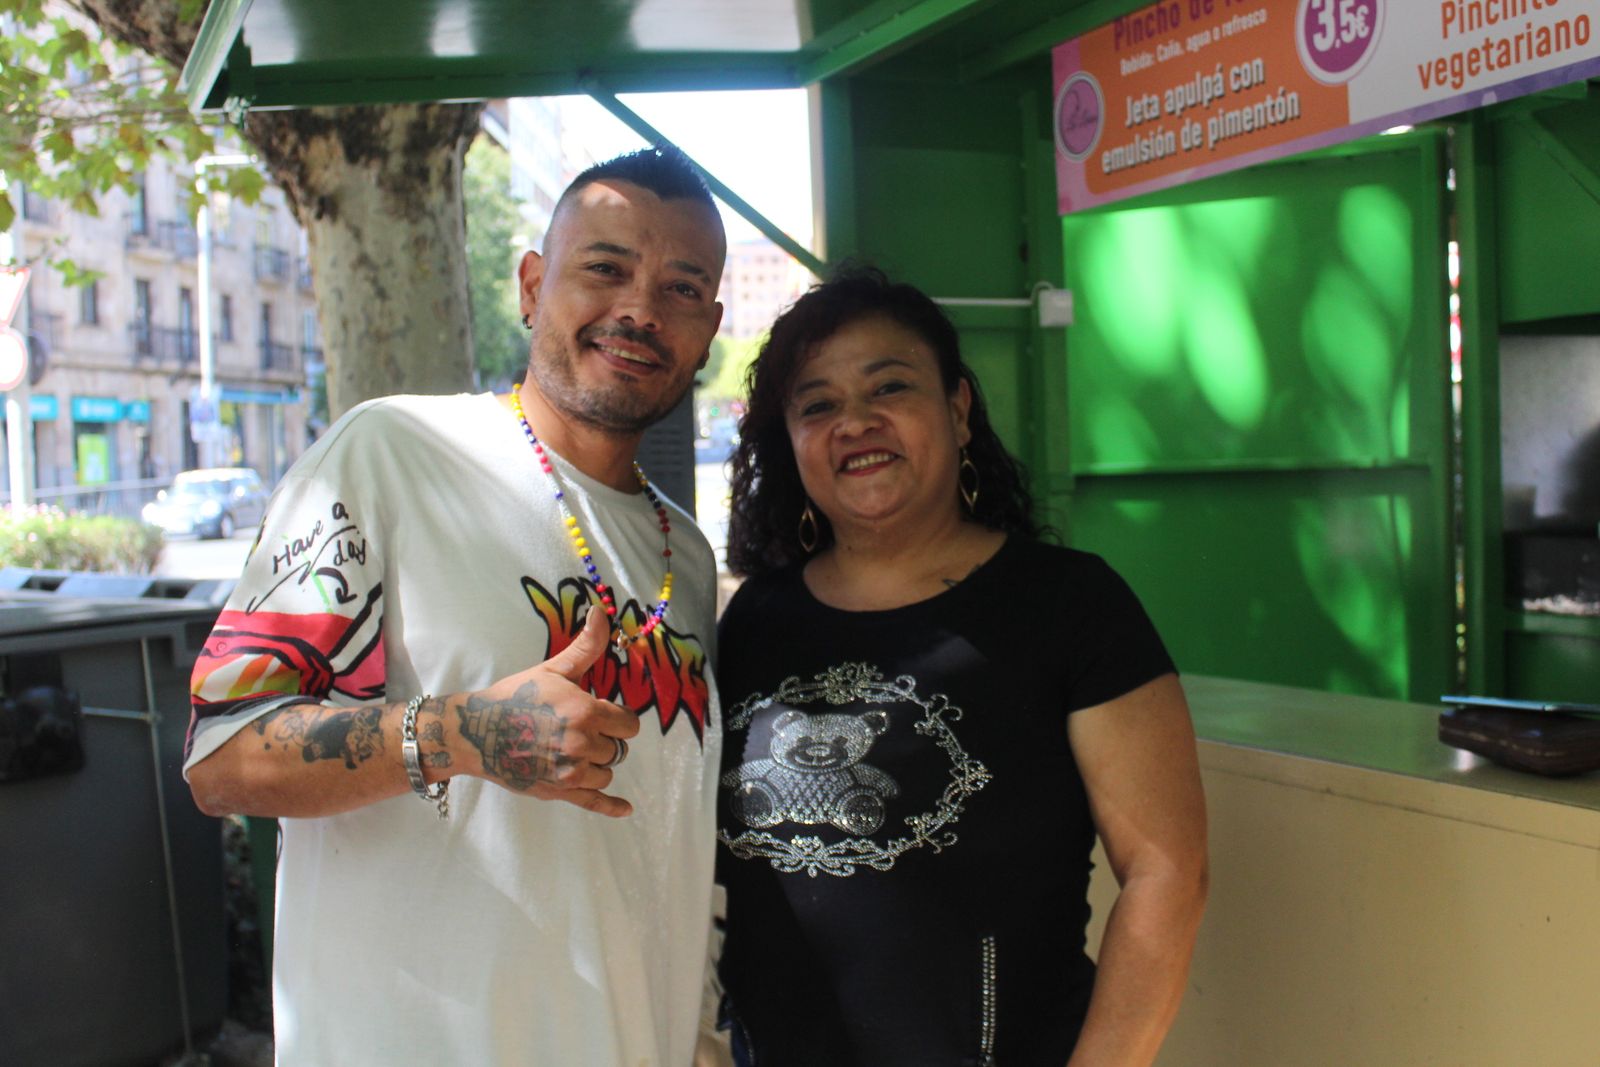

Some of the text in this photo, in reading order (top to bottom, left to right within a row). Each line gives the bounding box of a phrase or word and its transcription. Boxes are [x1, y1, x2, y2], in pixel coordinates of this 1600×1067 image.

[1186, 30, 1211, 52] agua
[1222, 8, 1266, 35] refresco
[1418, 14, 1590, 90] vegetariano
[1125, 95, 1160, 127] Jeta
[1164, 63, 1225, 118] apulpá
[1230, 57, 1265, 92] con
[1102, 88, 1301, 174] emulsión de pimentón
[273, 502, 349, 574] Have a
[333, 537, 366, 566] day
